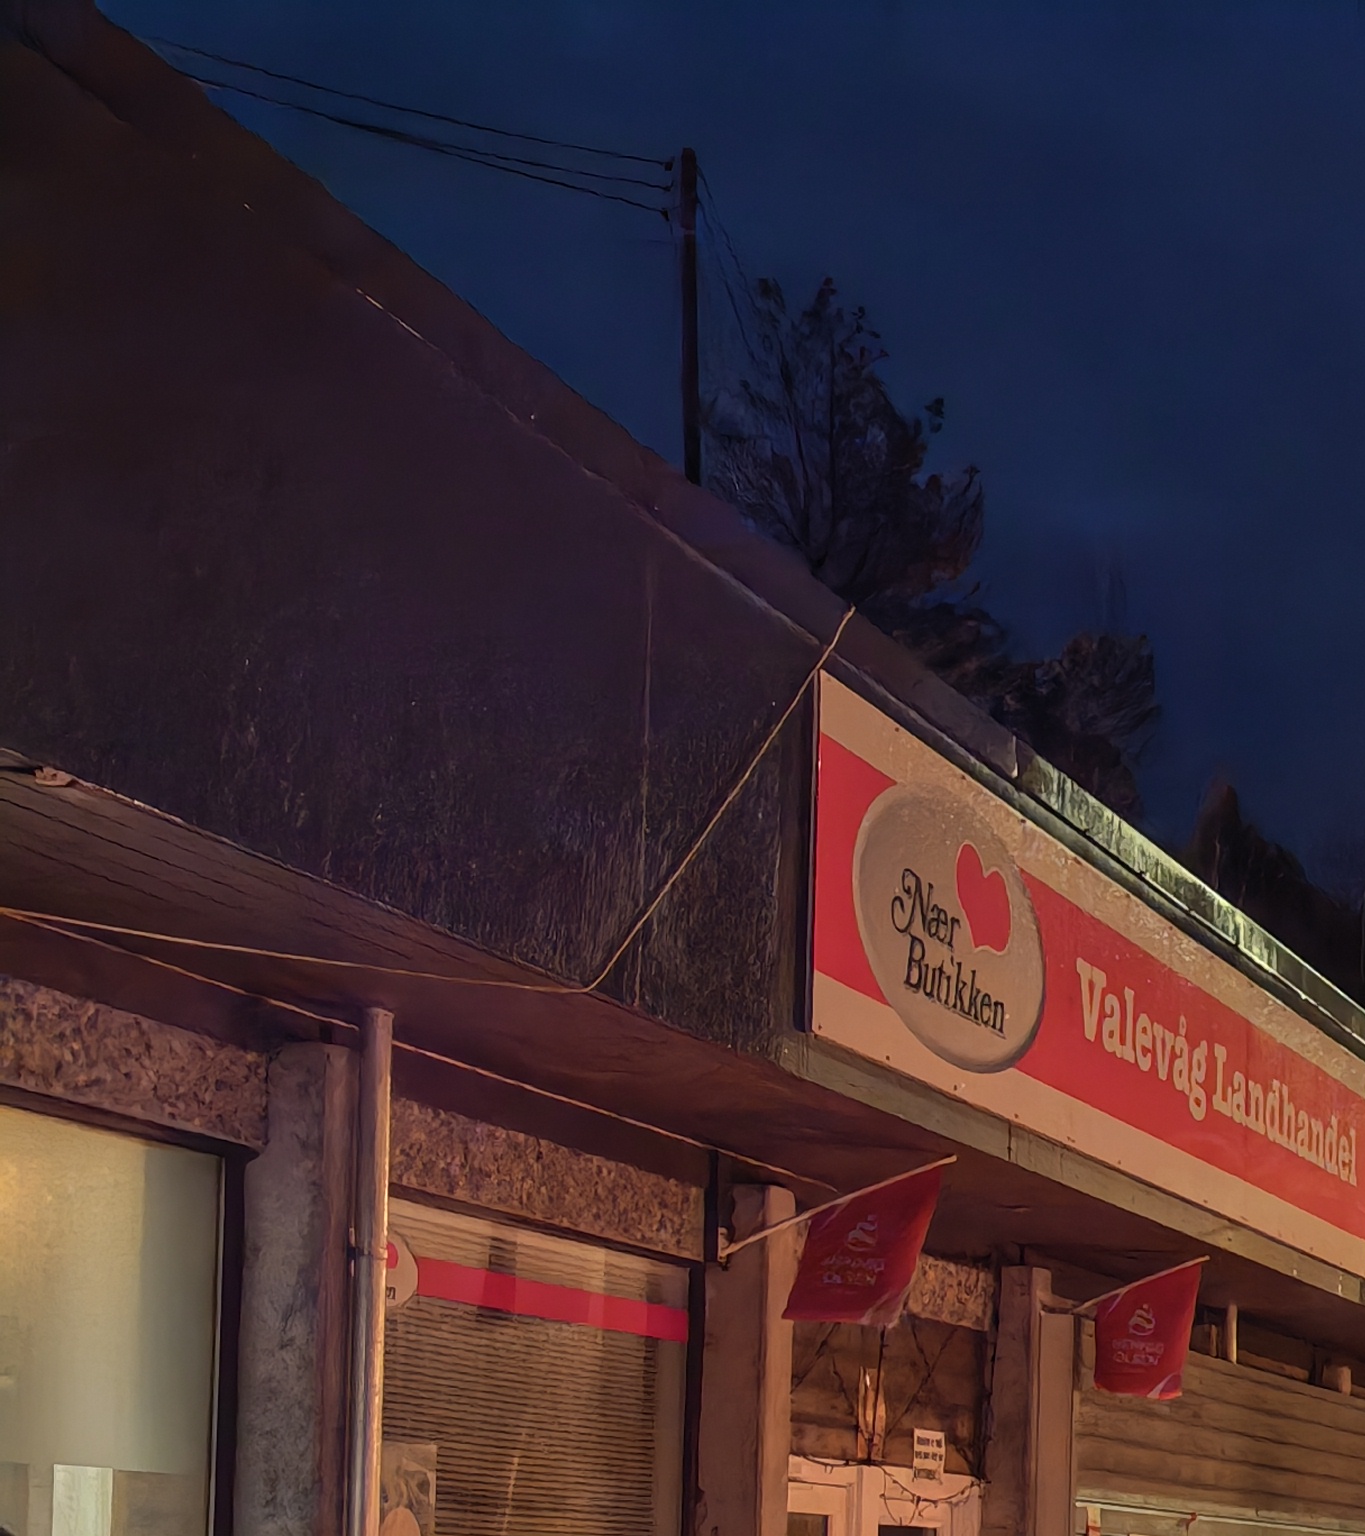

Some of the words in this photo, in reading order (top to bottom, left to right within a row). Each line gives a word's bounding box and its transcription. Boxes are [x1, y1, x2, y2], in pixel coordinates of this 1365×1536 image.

[891, 868, 961, 948] Nær
[904, 932, 1006, 1036] Butikken
[1076, 957, 1207, 1121] Valevåg
[1212, 1043, 1357, 1187] Landhandel
